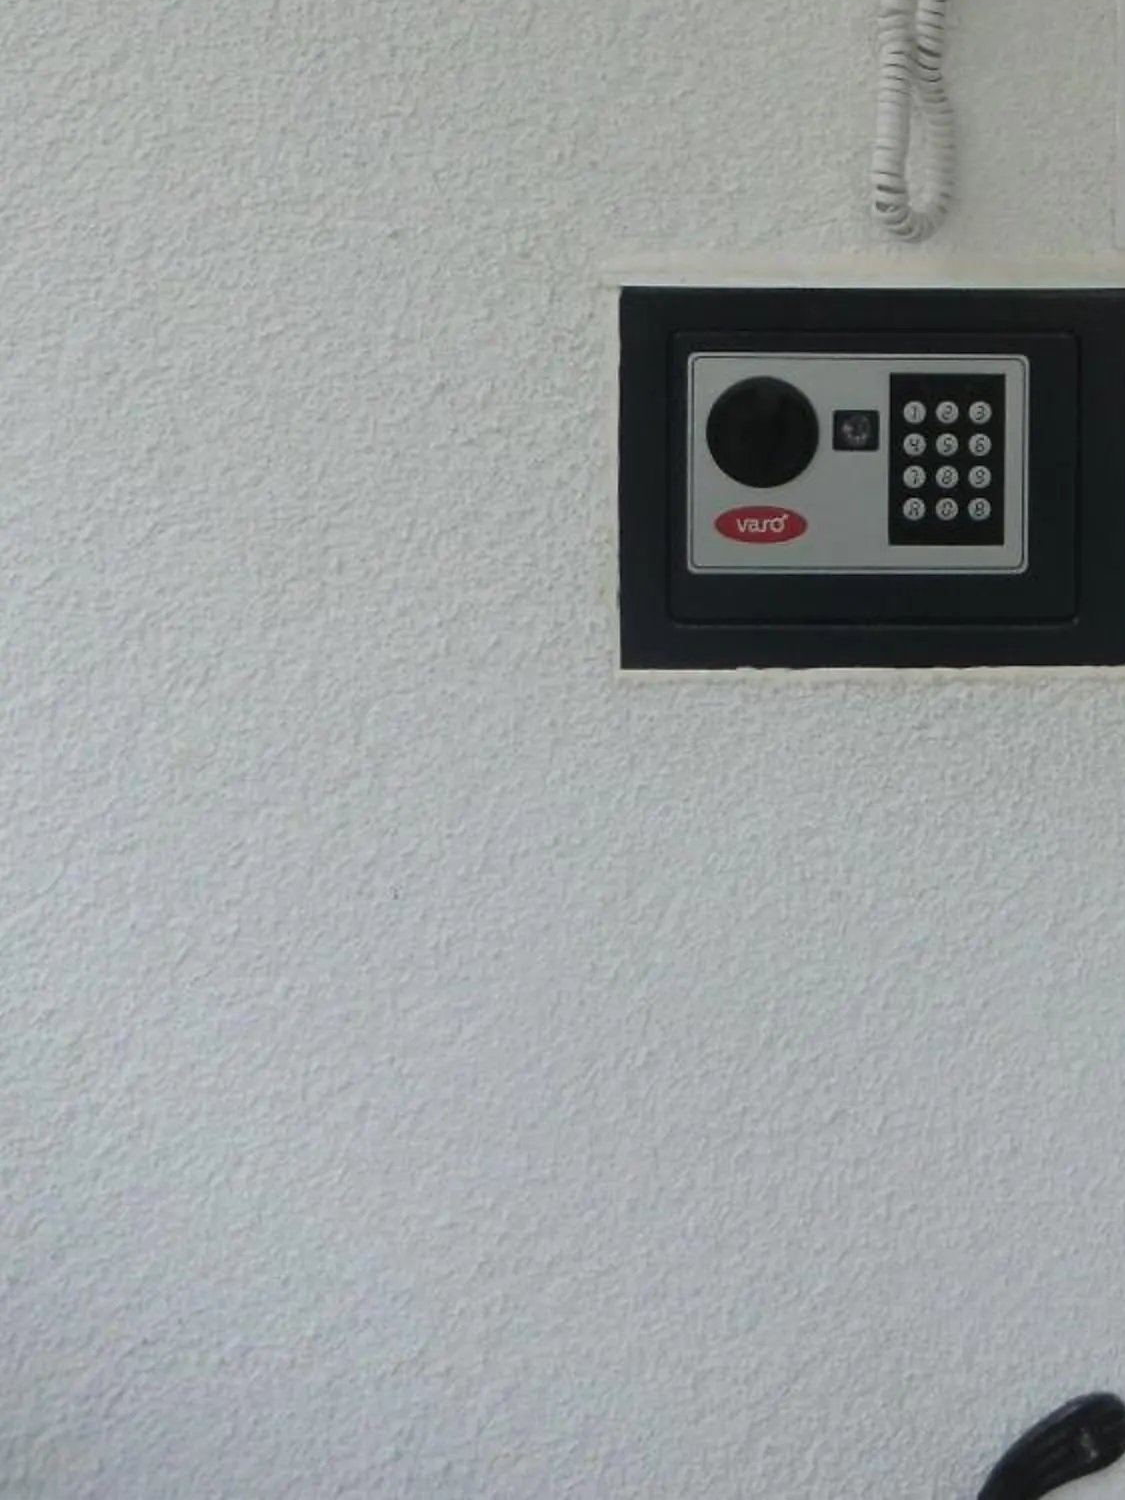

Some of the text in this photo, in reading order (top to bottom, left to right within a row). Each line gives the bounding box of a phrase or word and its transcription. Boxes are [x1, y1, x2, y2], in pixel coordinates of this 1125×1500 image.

[943, 405, 953, 420] 2
[975, 405, 985, 420] 3
[909, 437, 985, 453] 4 5 6
[911, 469, 985, 485] 7 8 9
